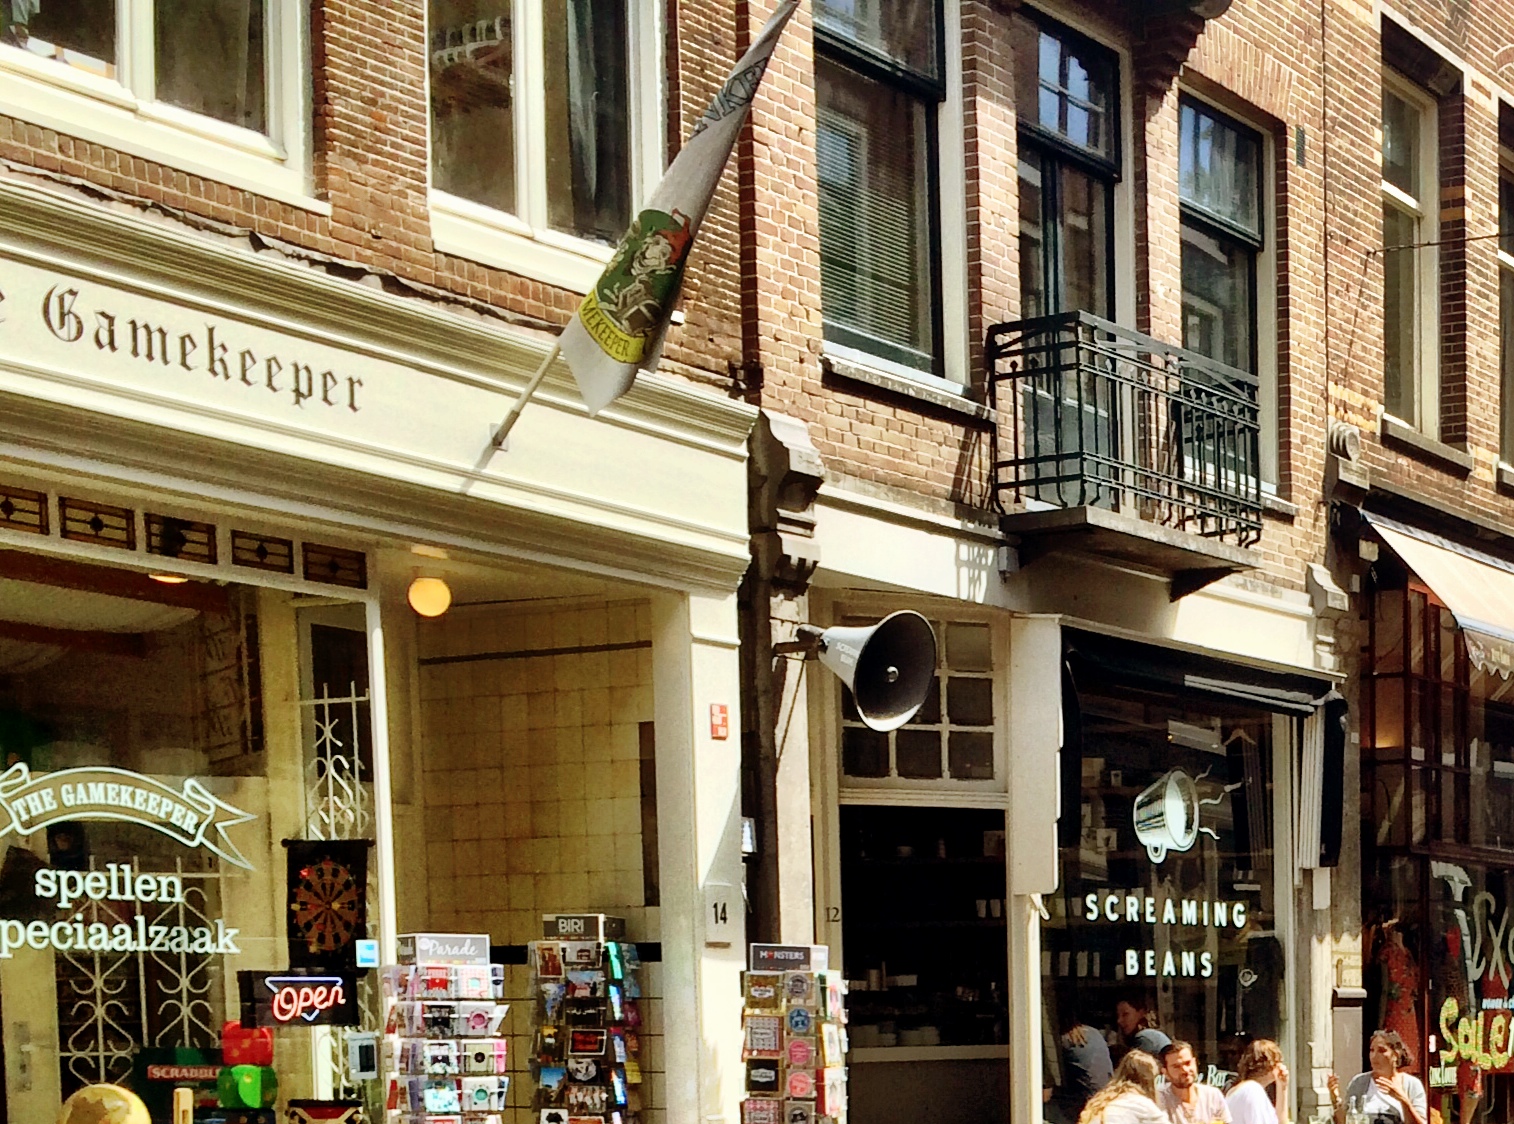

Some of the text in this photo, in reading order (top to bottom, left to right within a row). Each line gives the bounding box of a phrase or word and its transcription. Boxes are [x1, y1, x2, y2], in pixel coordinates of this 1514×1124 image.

[582, 297, 630, 357] MEKEEPER
[42, 282, 364, 413] Gamekeeper
[11, 781, 200, 835] THE GAMEKEEPER
[34, 863, 186, 909] spellen
[712, 901, 728, 925] 14
[825, 906, 842, 923] 12
[1085, 893, 1247, 928] SCREAMING
[0, 913, 240, 959] peciaalzaak
[428, 938, 479, 957] Parade
[1125, 949, 1213, 978] BEANS
[272, 984, 347, 1022] Open
[1207, 1064, 1229, 1087] Bar
